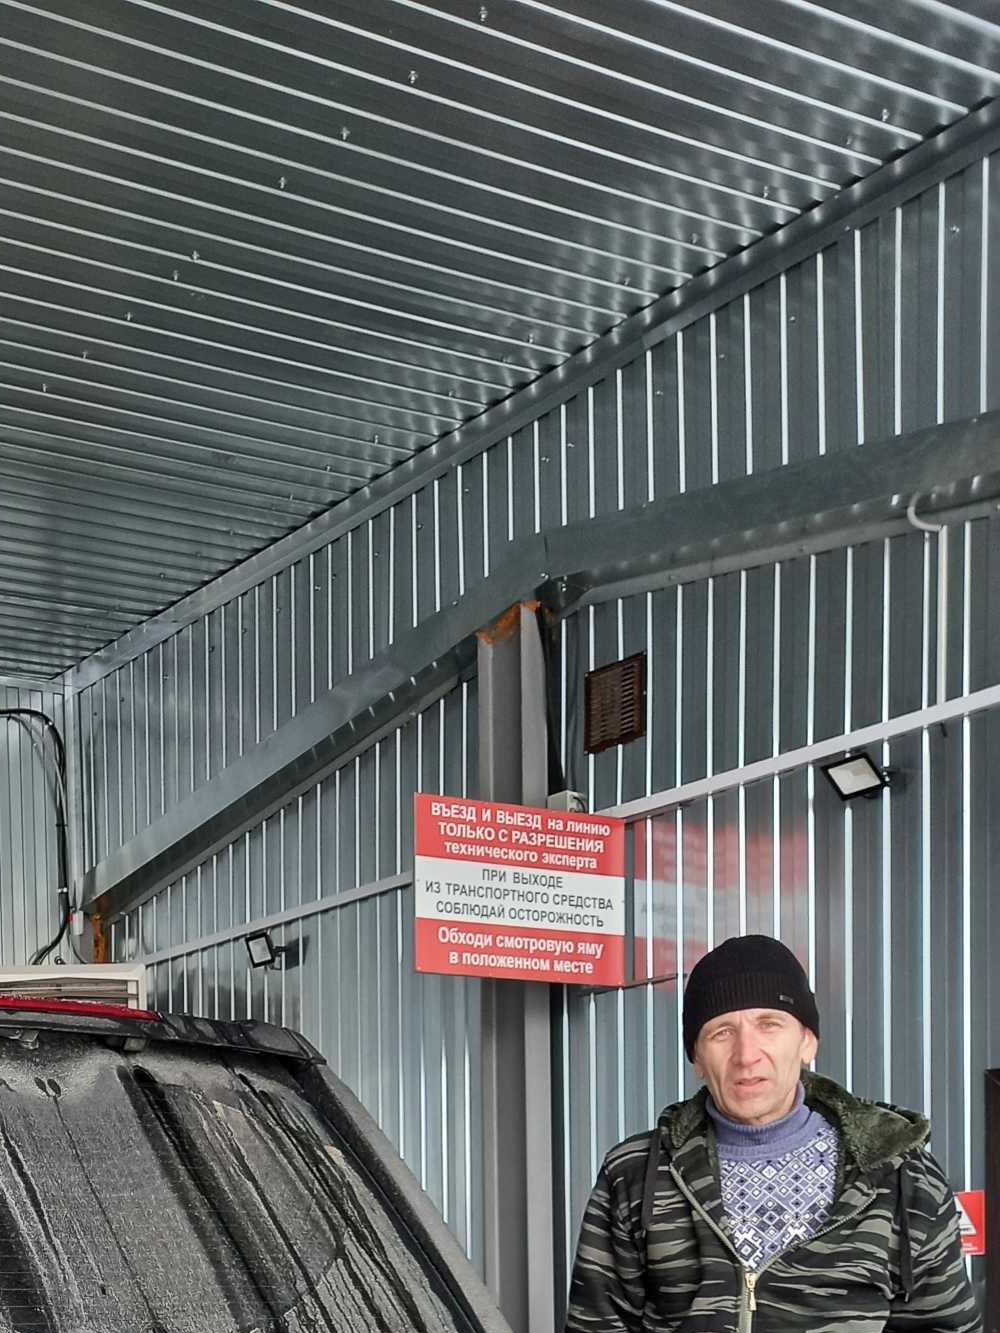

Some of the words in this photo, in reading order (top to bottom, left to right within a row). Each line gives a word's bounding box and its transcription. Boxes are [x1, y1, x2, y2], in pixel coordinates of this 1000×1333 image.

[431, 802, 476, 822] ВЪЕЗД
[482, 810, 491, 821] И
[496, 810, 542, 829] ВЫЕЗД
[548, 818, 563, 829] на
[567, 821, 610, 836] линию
[439, 821, 495, 841] ТОЛЬКО
[499, 829, 507, 841] С
[512, 830, 604, 853] РАЗРЕШЕНИЯ
[444, 841, 538, 863] технического
[542, 852, 597, 870] эксперта
[482, 869, 506, 882] ПРИ
[513, 872, 563, 889] ВЫХОДЕ
[425, 881, 441, 894] ИЗ
[446, 883, 549, 904] ТРАНСПОРТНОГО
[553, 893, 613, 910] СРЕДСТВА
[436, 901, 505, 919] СОБЛЮДАЙ
[509, 908, 604, 927] ОСТОРОЖНОСТЬ
[439, 927, 493, 948] Обходи
[496, 935, 574, 953] смотровую
[577, 941, 603, 959] яму
[450, 953, 458, 964] в
[463, 954, 550, 970] положенном
[554, 960, 593, 974] месте
